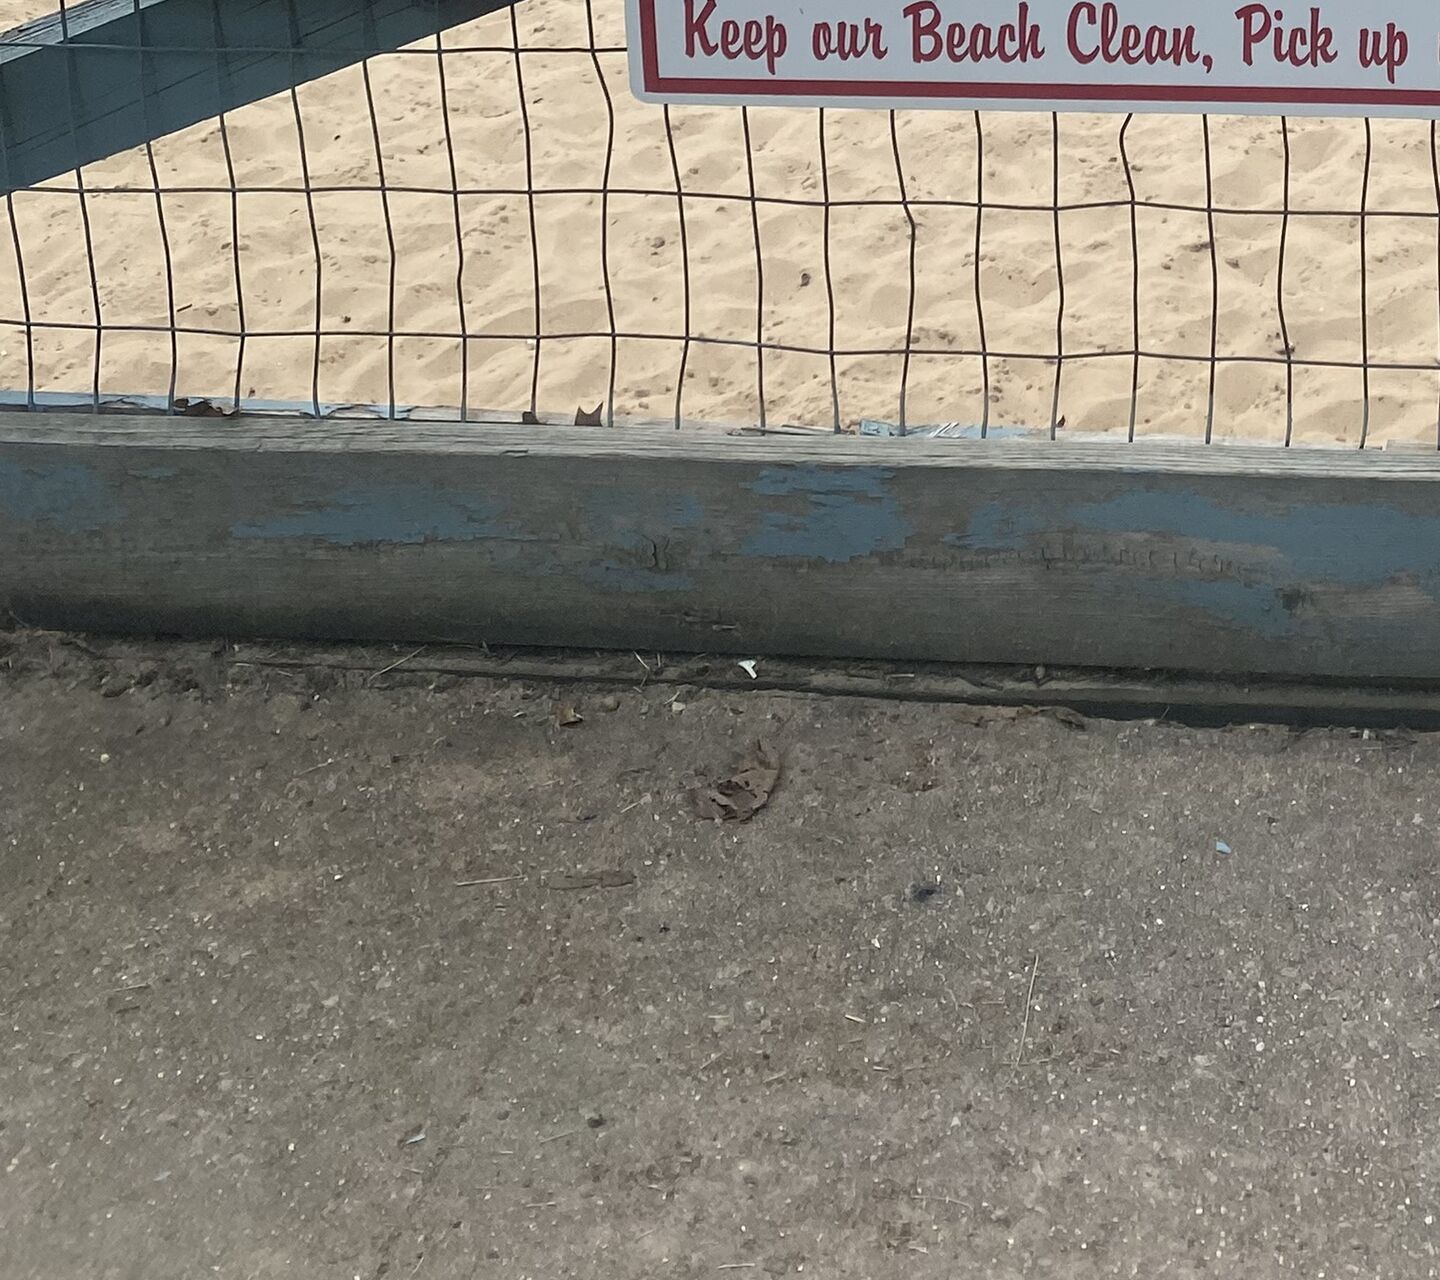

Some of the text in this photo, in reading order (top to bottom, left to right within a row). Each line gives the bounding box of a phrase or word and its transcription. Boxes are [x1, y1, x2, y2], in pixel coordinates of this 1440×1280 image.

[812, 17, 889, 61] our
[902, 0, 1046, 64] Beach
[1066, 1, 1213, 74] Clean,
[1234, 3, 1338, 68] Pick
[1359, 22, 1408, 76] up
